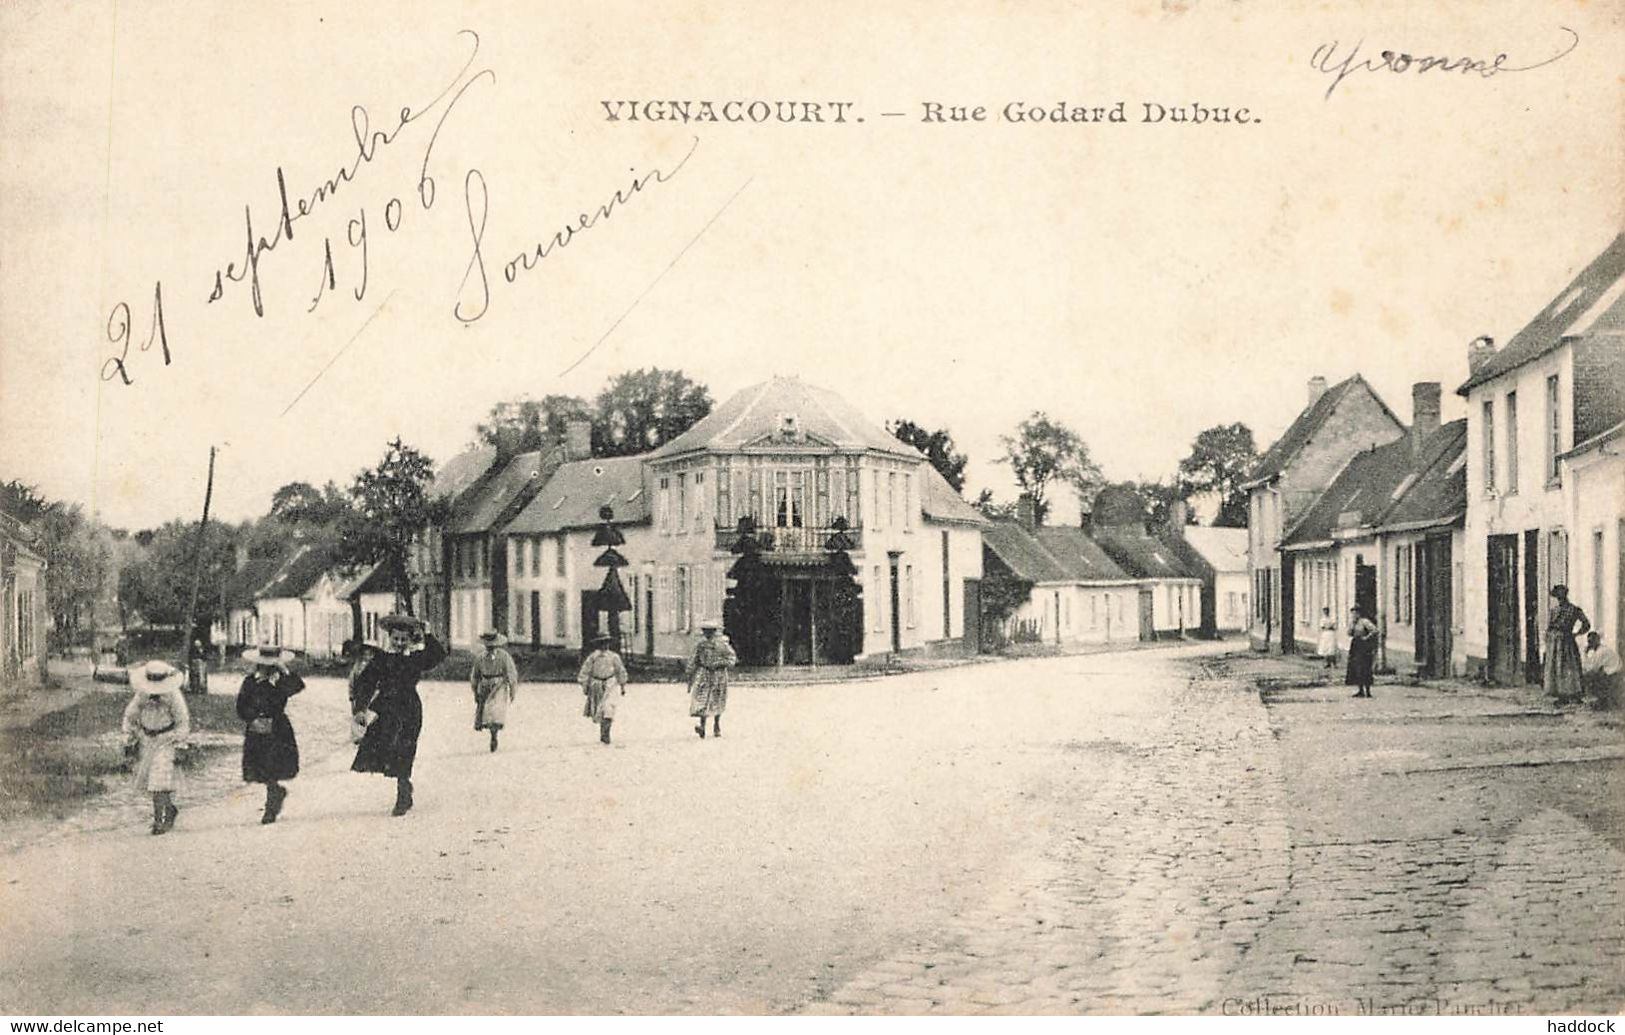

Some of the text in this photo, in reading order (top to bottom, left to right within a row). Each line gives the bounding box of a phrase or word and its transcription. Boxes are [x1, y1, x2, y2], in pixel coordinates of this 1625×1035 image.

[101, 29, 480, 385] 21 septembre
[308, 69, 496, 313] 1906
[600, 100, 865, 124] VIGNACOURT.
[920, 101, 987, 123] Rue
[1002, 101, 1128, 123] Godard
[1141, 101, 1262, 124] Dubuc.
